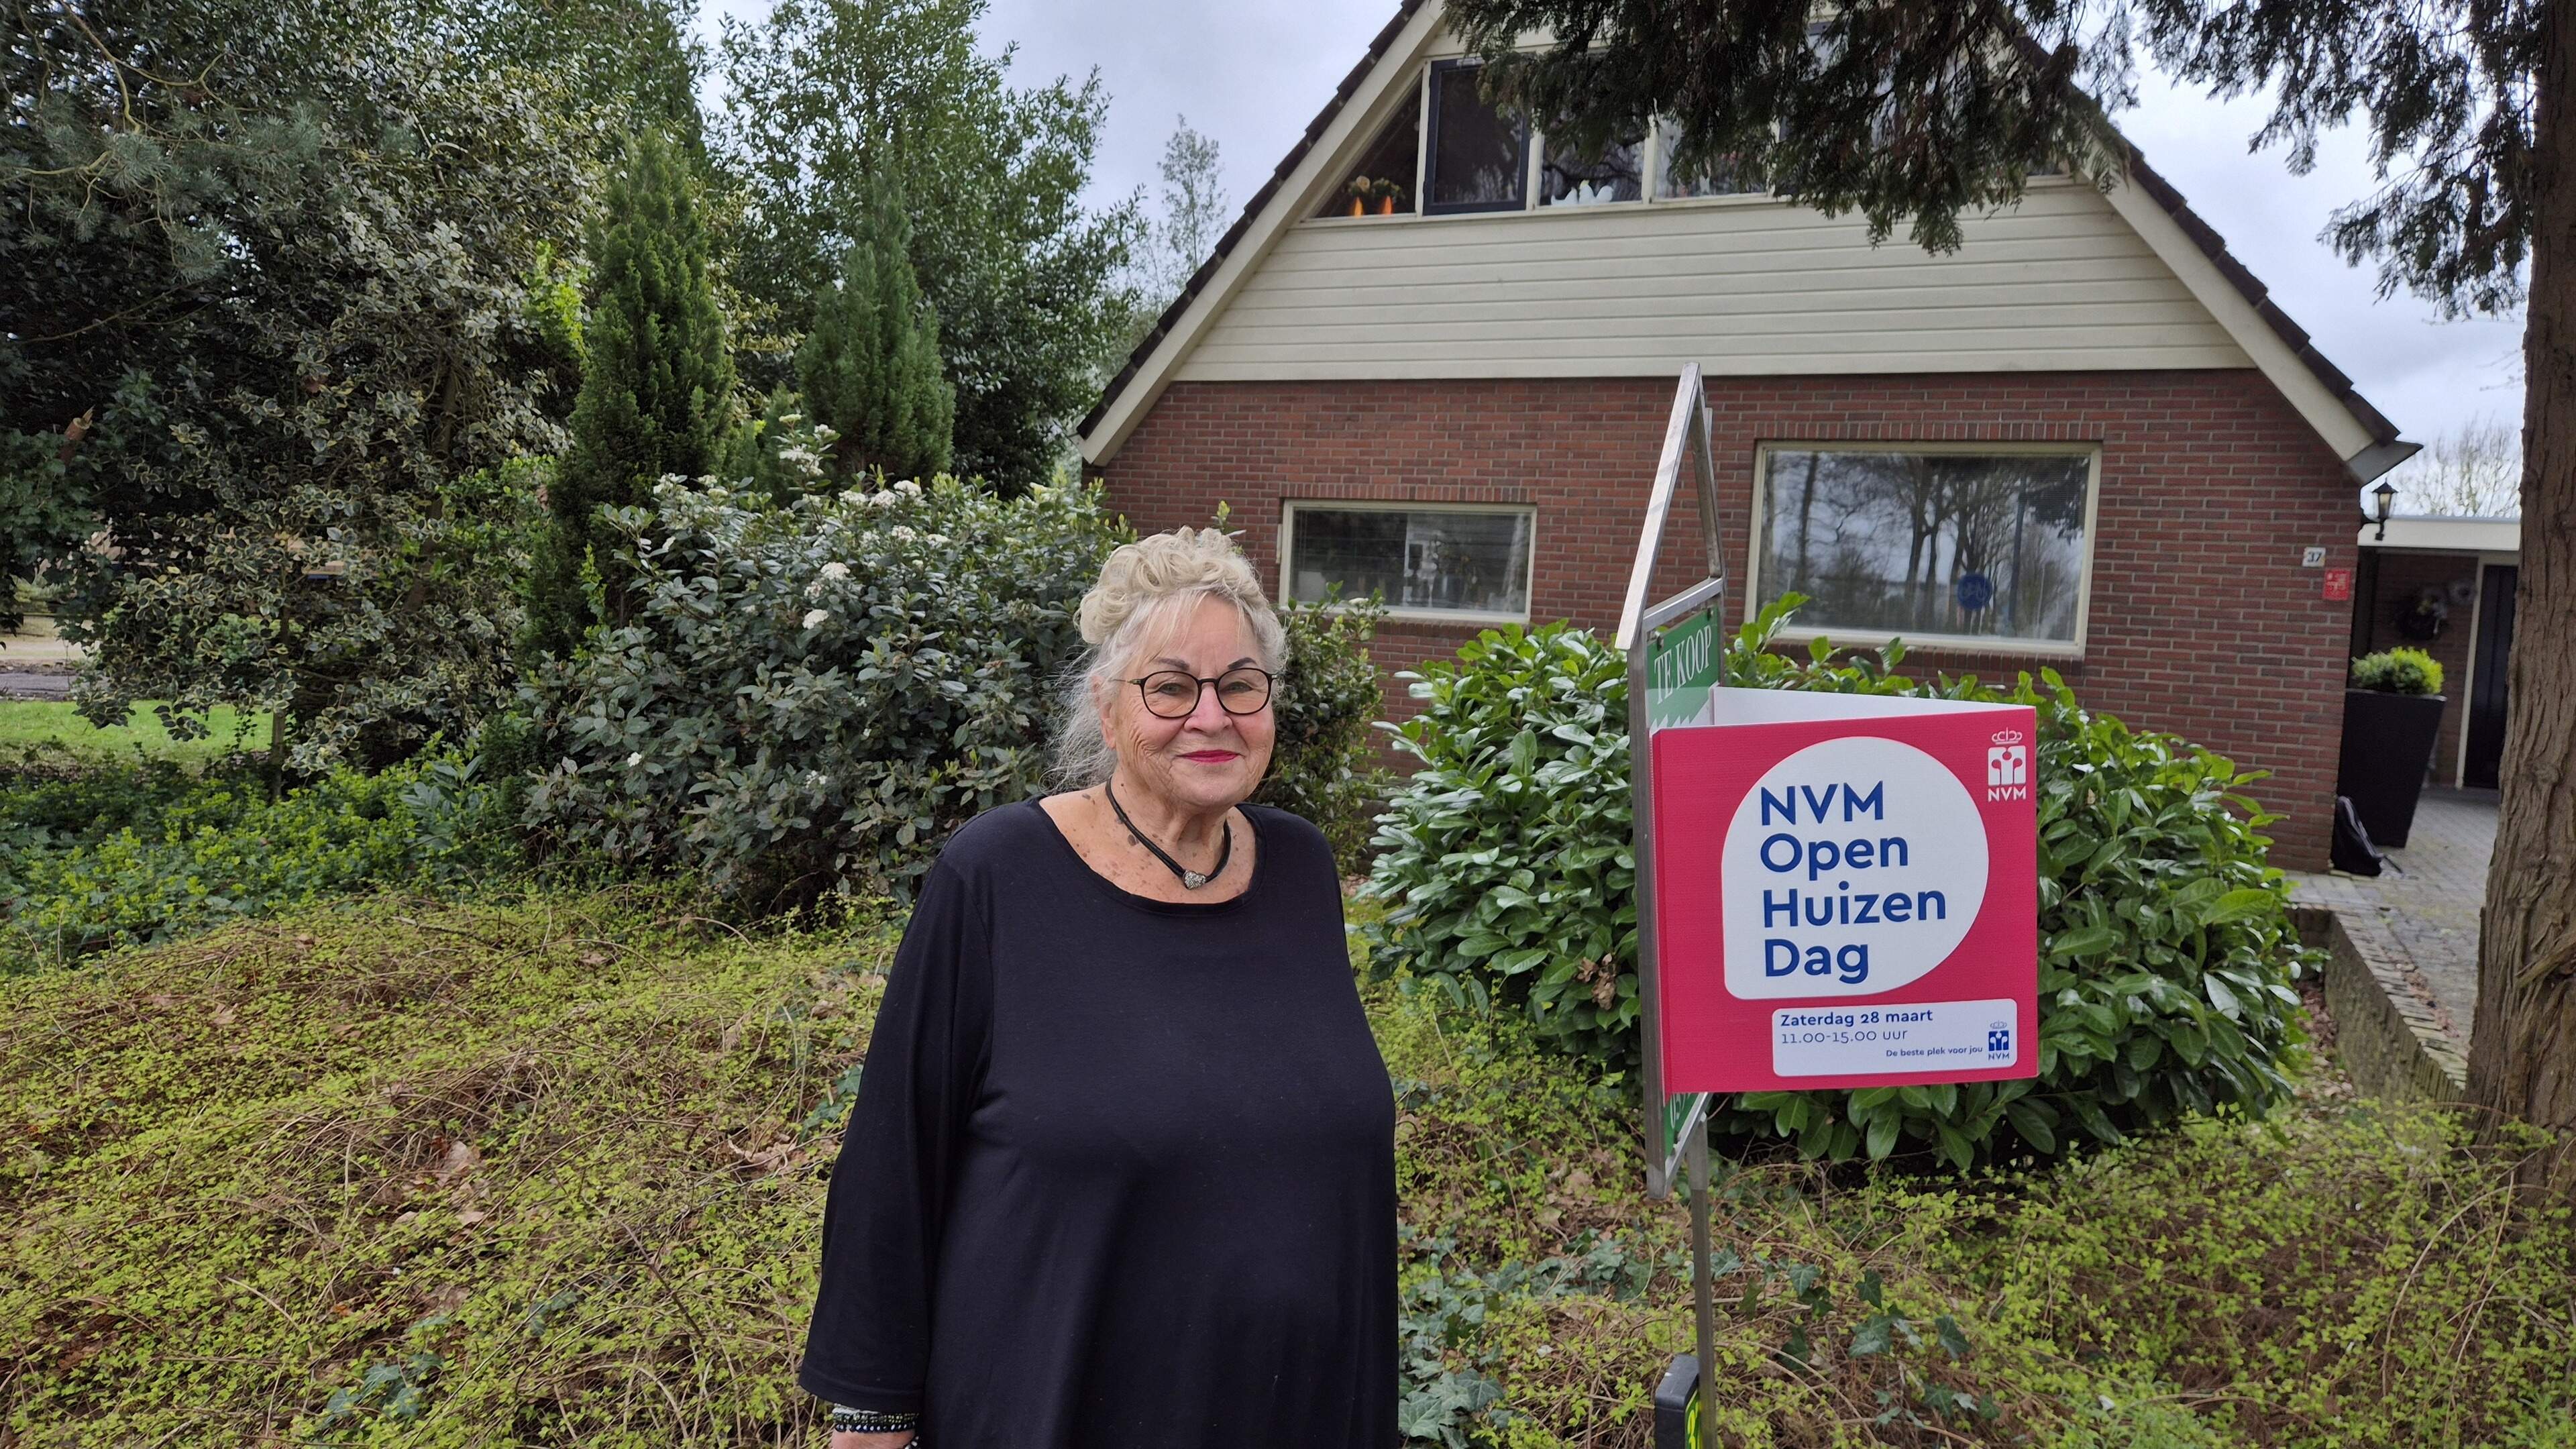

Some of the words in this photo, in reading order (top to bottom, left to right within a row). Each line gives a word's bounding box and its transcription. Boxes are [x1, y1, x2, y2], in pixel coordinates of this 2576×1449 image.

[2307, 551, 2322, 563] 37
[1654, 649, 1674, 705] TE
[1675, 624, 1712, 690] KOOP
[1761, 780, 1884, 826] NVM
[1988, 786, 2026, 802] NVM
[1760, 833, 1908, 881] Open
[1763, 881, 1946, 928] Huizen
[1764, 938, 1869, 984] Dag
[1780, 1012, 1854, 1027] Zaterdag
[1860, 1011, 1880, 1024] 28
[1886, 1009, 1933, 1022] maart
[1782, 1030, 1877, 1044] 11.00-15.00
[1882, 1030, 1908, 1040] uur
[1886, 1049, 1898, 1057] De
[1900, 1048, 1925, 1057] beste
[1927, 1046, 1945, 1057] plek
[1969, 1045, 1983, 1055] jou
[1988, 1053, 2010, 1061] NVM
